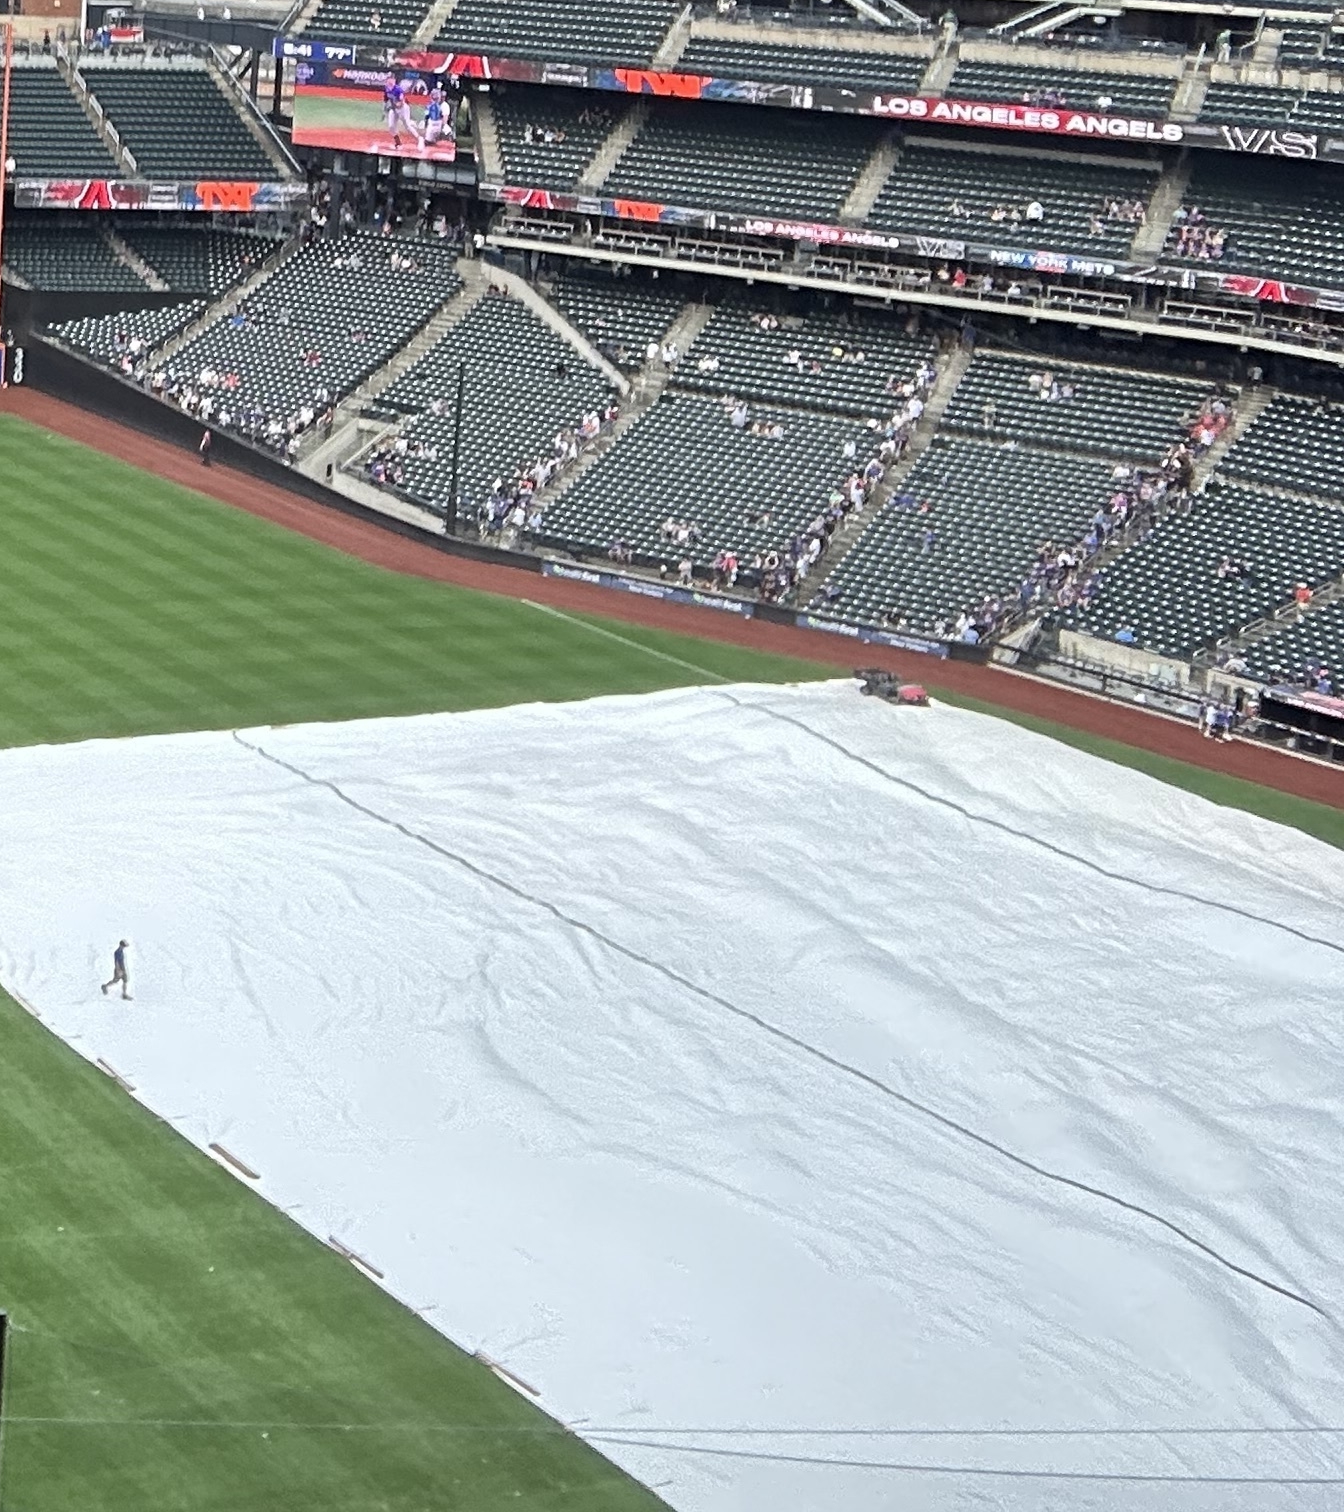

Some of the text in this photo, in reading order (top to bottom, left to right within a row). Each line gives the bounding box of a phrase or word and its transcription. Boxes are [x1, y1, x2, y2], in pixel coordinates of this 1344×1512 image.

[873, 95, 927, 116] LOS
[931, 101, 1061, 130] ANGELES
[1066, 111, 1184, 142] ANGELS
[745, 219, 774, 235] LOS
[773, 222, 840, 241] ANGELES
[842, 231, 900, 249] ANGELS
[990, 250, 1026, 267] NEW
[1028, 254, 1068, 271] YORK
[1071, 258, 1116, 276] METS
